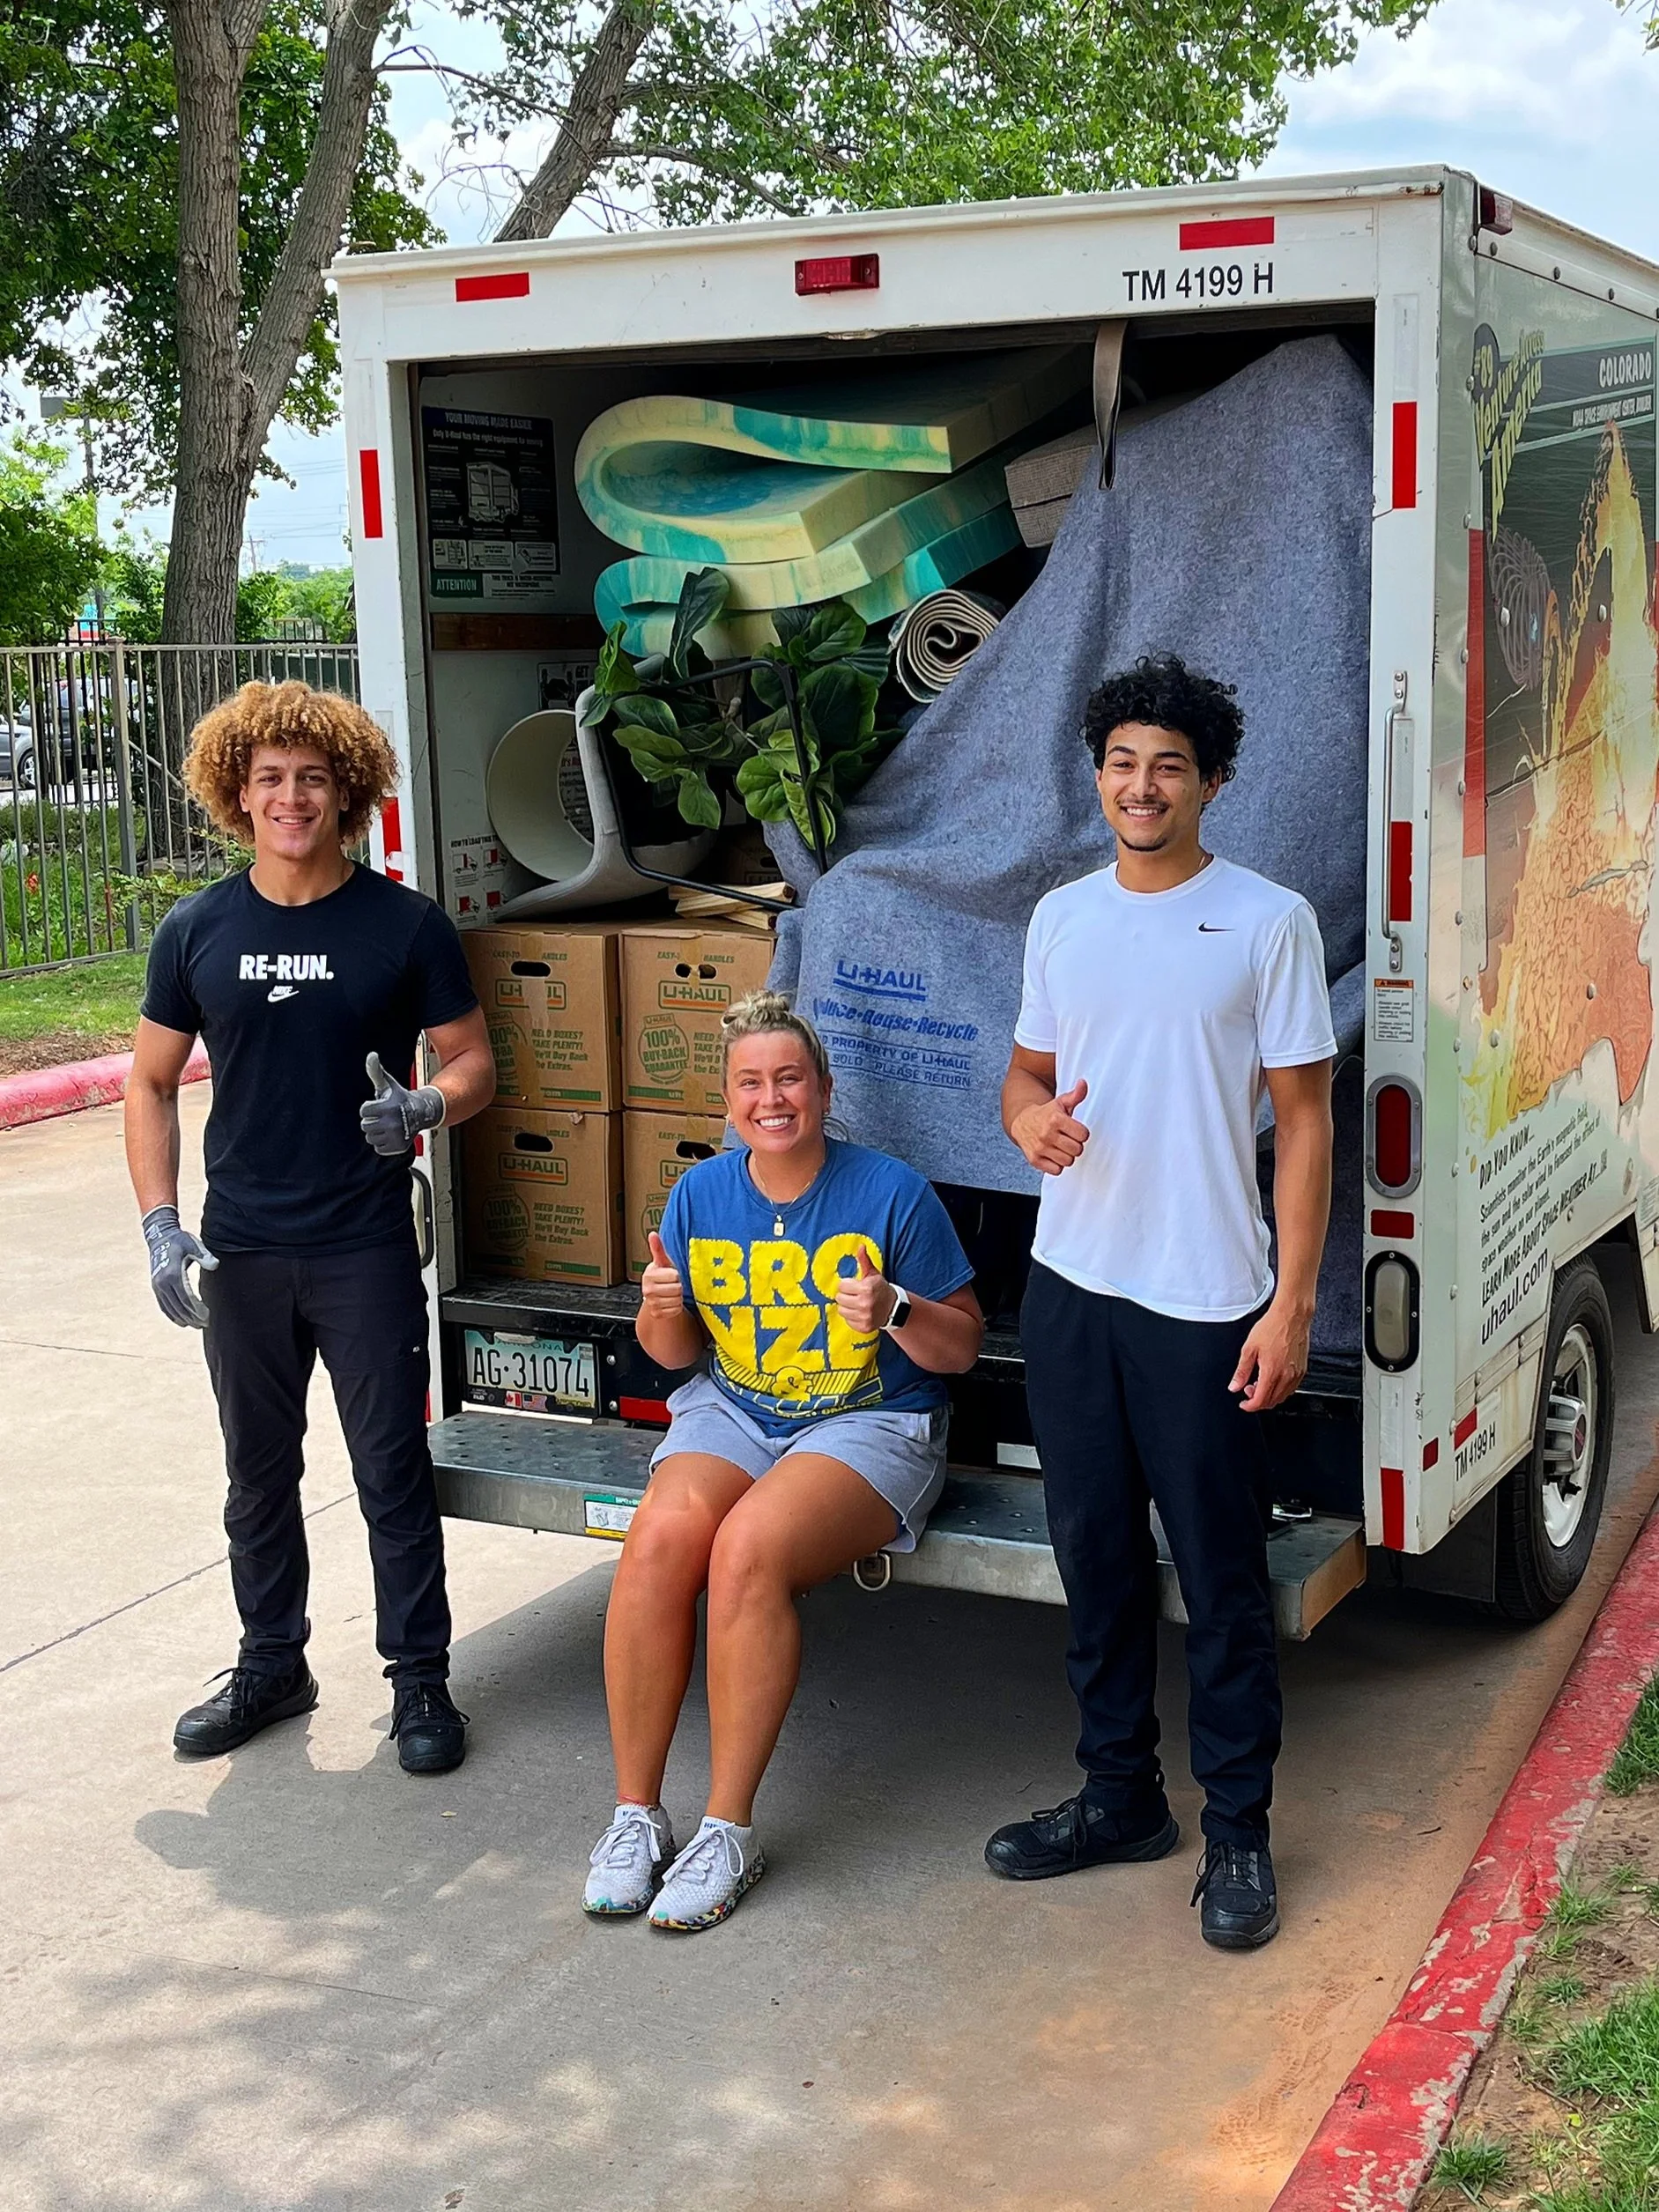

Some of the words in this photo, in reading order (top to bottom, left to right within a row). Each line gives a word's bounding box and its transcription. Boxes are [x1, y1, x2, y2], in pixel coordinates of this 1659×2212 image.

[1122, 269, 1166, 301] TM
[1175, 264, 1243, 299] 4199
[1253, 262, 1274, 294] H
[1599, 351, 1652, 388] COLORADO
[436, 578, 477, 591] ATTENTION
[239, 954, 335, 980] RE-RUN.
[837, 959, 927, 992] U-HAUL
[272, 985, 294, 996] NIKE
[663, 985, 727, 1002] U-HAUL
[644, 1028, 681, 1048] 100%
[693, 1032, 715, 1042] NEED
[694, 1042, 713, 1053] TAKE
[832, 1037, 897, 1059] PROPERTY
[901, 1049, 918, 1063] OF
[922, 1054, 970, 1071] U-HAUL
[833, 1053, 863, 1067] SOLD
[874, 1062, 920, 1081] PLEASE
[923, 1071, 971, 1088] RETURN
[503, 1157, 564, 1175] U-HAUL
[1479, 1159, 1492, 1190] DID
[1493, 1143, 1508, 1176] YOU
[1480, 1187, 1507, 1224] Scientists
[1528, 1155, 1537, 1174] the
[1537, 1138, 1554, 1165] Earth's
[1481, 1229, 1491, 1248] the
[1492, 1218, 1500, 1237] sun
[1501, 1200, 1511, 1225] and
[1512, 1195, 1521, 1216] the
[1482, 1264, 1503, 1309] LEARN
[1503, 1244, 1522, 1284] MORE
[1522, 1220, 1541, 1259] ABOUT
[1541, 1199, 1559, 1237] SPACE
[1559, 1171, 1588, 1216] WEATHER
[1498, 1224, 1517, 1255] weather
[688, 1232, 884, 1306] BRO
[1481, 1247, 1549, 1346] uhaul.com
[1455, 1446, 1468, 1482] TM
[1469, 1428, 1487, 1466] 4199
[1488, 1420, 1496, 1451] H
